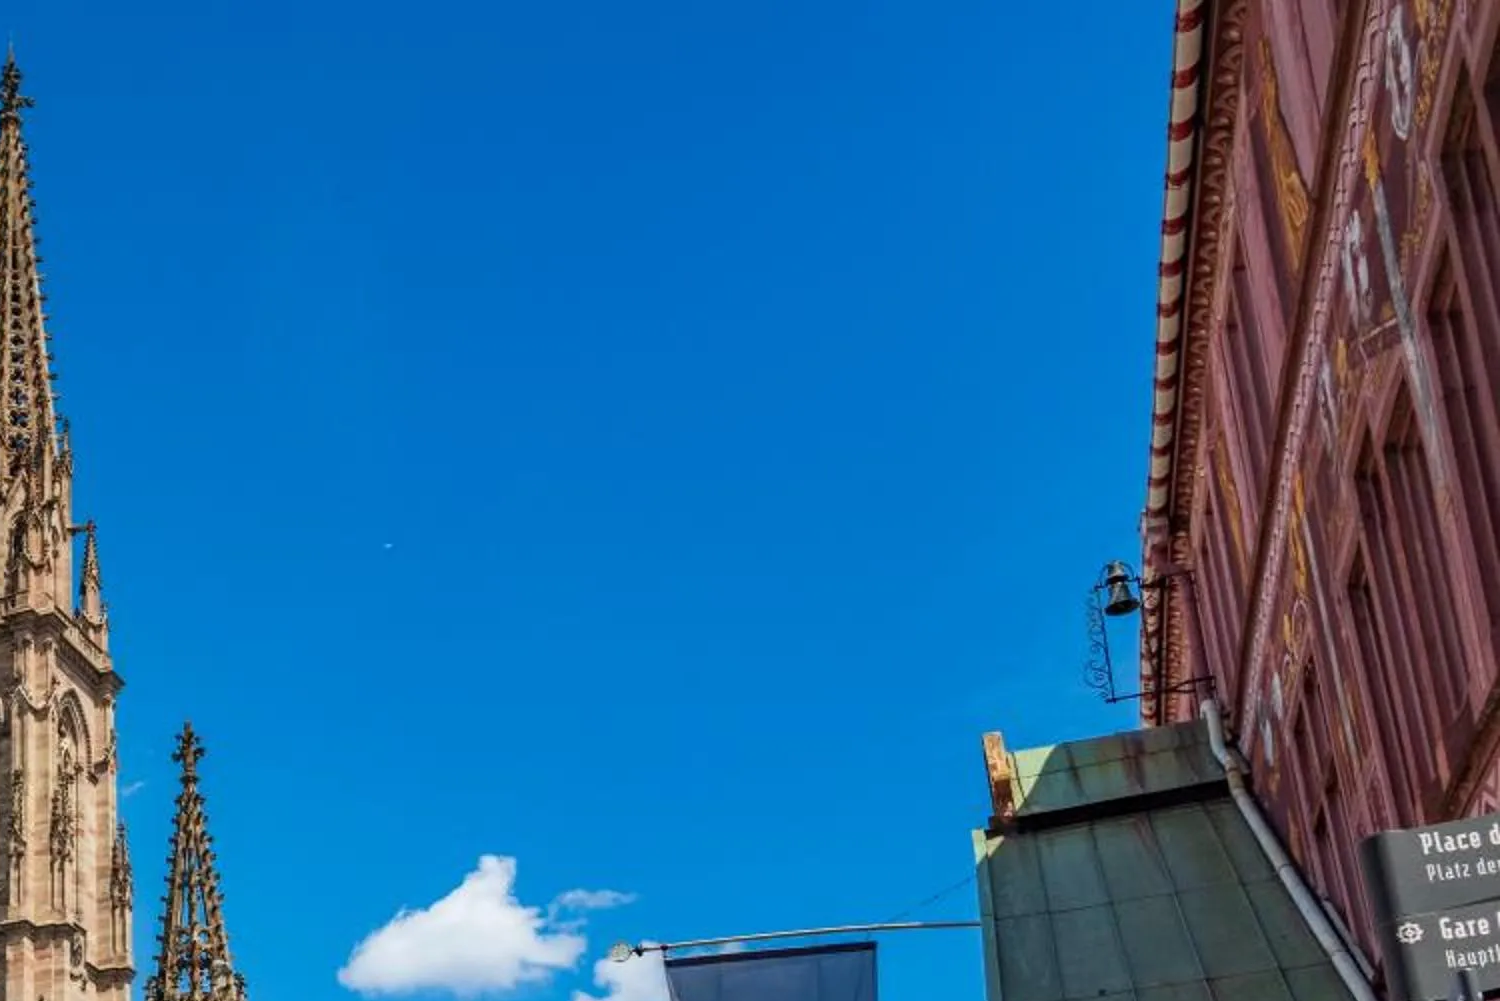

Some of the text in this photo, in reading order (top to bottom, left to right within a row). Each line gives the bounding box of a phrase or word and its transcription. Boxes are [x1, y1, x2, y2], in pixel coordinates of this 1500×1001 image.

[1418, 830, 1482, 855] Place
[1425, 862, 1471, 882] Platz
[1438, 915, 1491, 941] Gare
